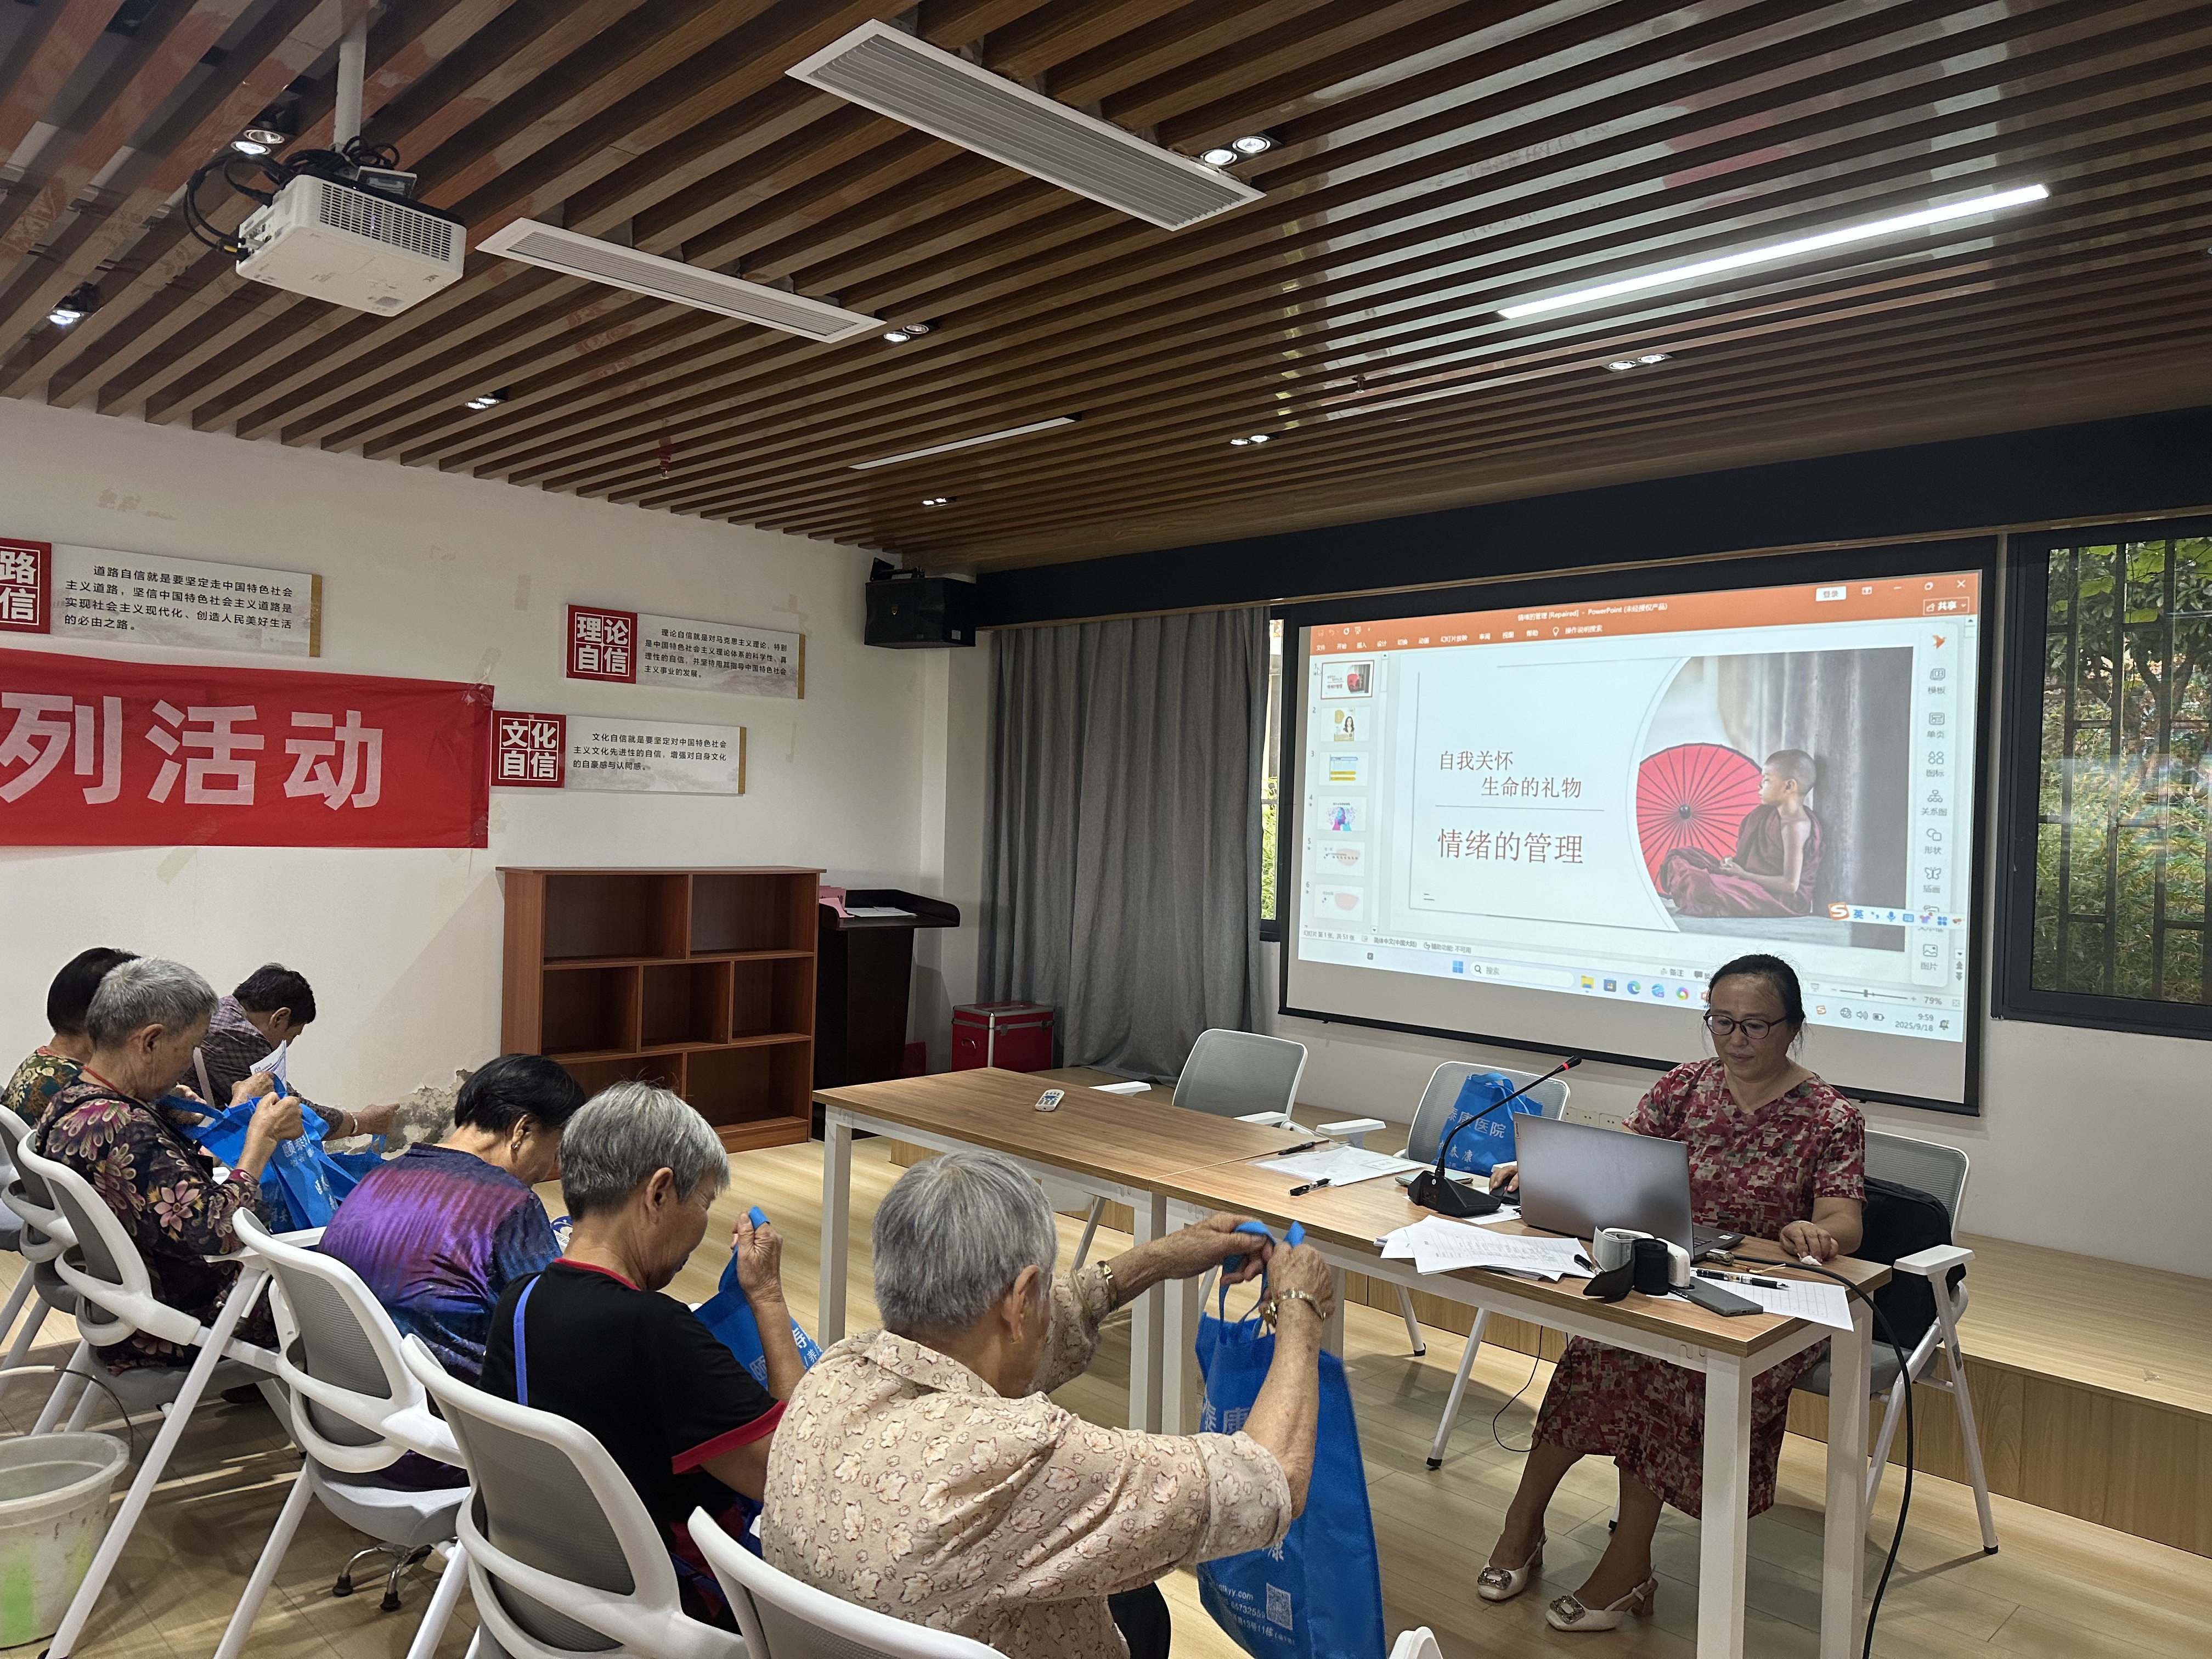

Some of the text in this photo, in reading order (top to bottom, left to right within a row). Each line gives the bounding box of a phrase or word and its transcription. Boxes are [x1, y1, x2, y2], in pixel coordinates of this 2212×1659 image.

[0, 551, 37, 584] 路
[93, 565, 293, 597] 道路自信就是要坚定走中国特色社会
[0, 587, 36, 620] 信
[65, 580, 292, 613] 主义道路，坚信中国特色社会主义道路是
[1938, 601, 1957, 611] 共享
[64, 615, 137, 631] 的必由之路。
[65, 597, 292, 629] 实现社会主义现代化、创造人民美好生活
[1549, 610, 1579, 619] [Repaired]
[1588, 607, 1622, 615] PowerPoint
[577, 616, 629, 645] 理论
[661, 629, 787, 652] 理论自信就是对马克思主义理论，特别
[577, 646, 628, 674] 自信
[645, 640, 787, 663] 是中国特色社会主义理论体系的科学性、真
[644, 665, 702, 678] 主义事业的发展。
[502, 721, 556, 749] 文化
[592, 733, 727, 748] 文化自信就是要坚定对中国特色社会
[0, 692, 383, 810] 列活动
[573, 746, 727, 761] 主义文化先进性的自信，增强对自身文化
[1440, 750, 1514, 771] 自我关怀
[503, 751, 556, 778] 自信
[573, 760, 646, 771] 的自豪感与认同感。
[1481, 776, 1582, 798] 生命的礼物
[1437, 828, 1583, 864] 情绪的管理
[1853, 909, 1864, 919] 英
[1924, 996, 1943, 1005] 79%
[1895, 1021, 1934, 1032] 2025/9/18
